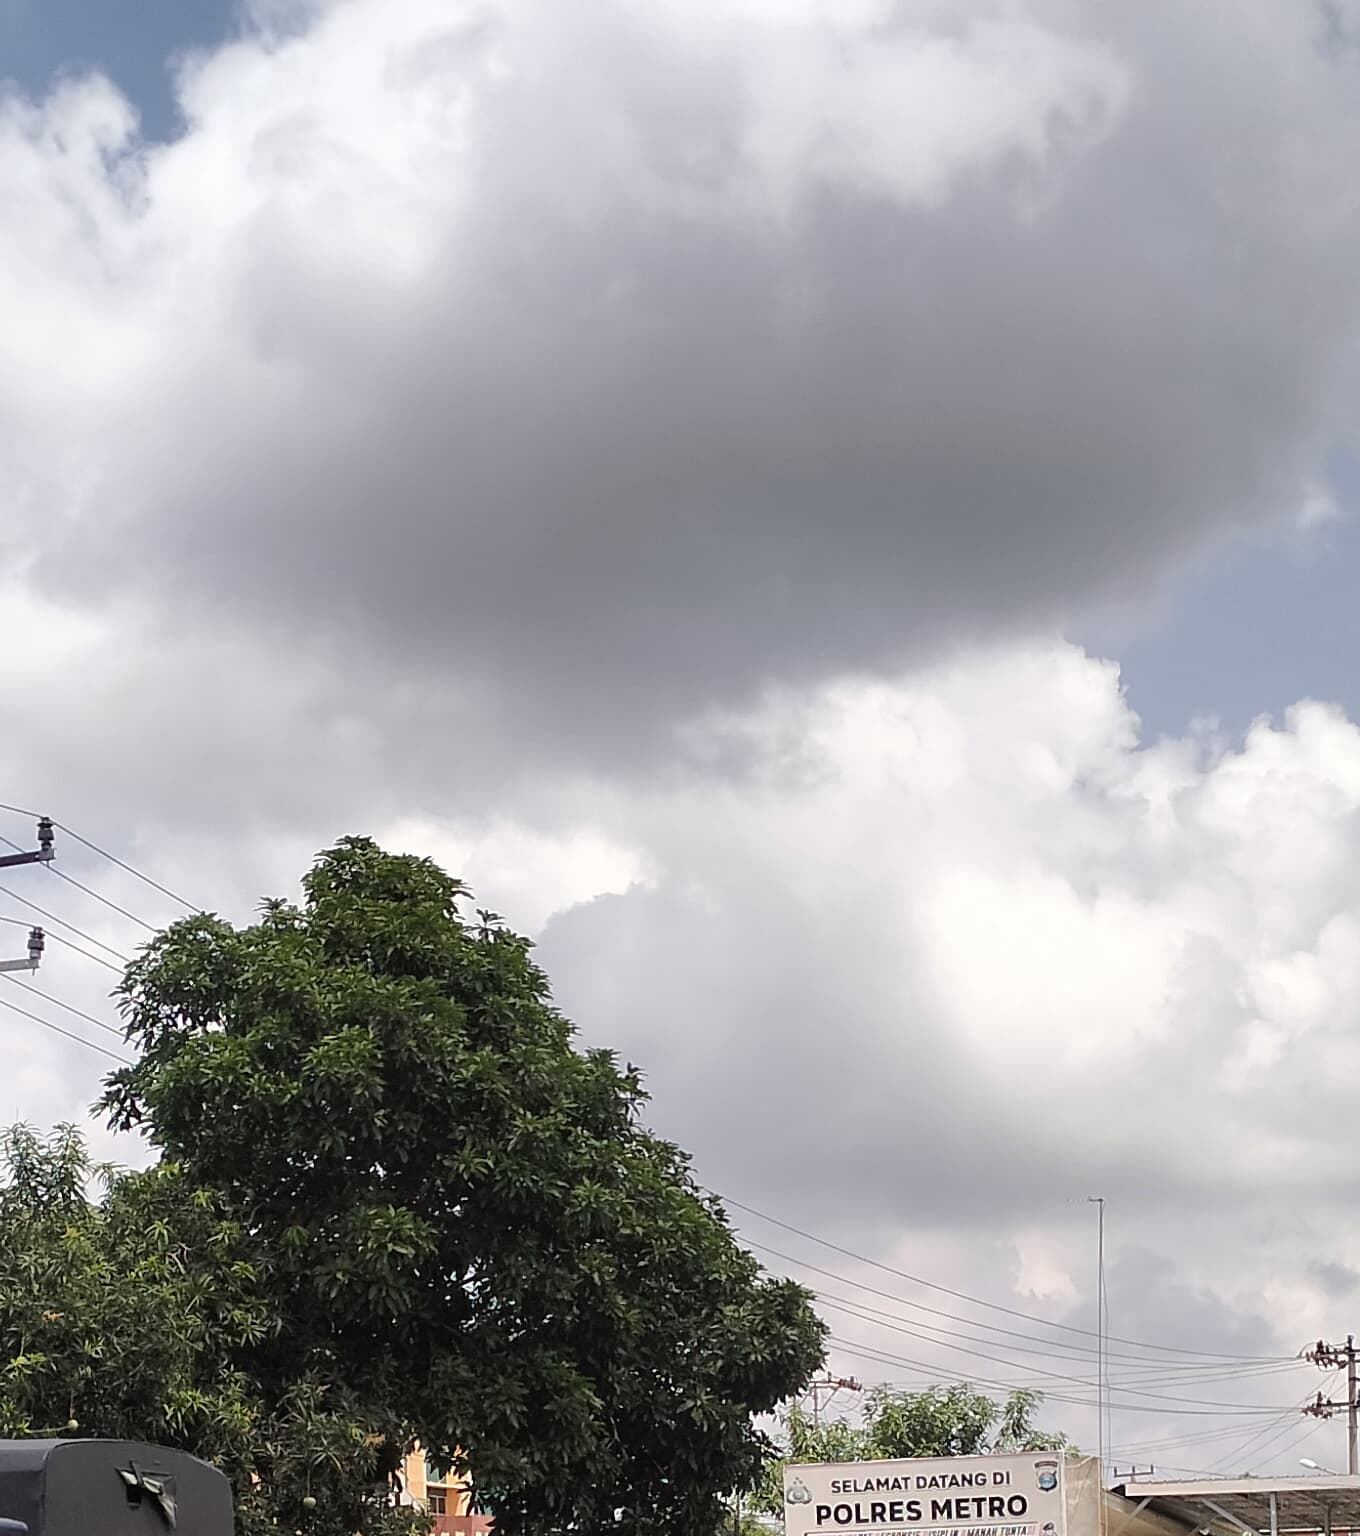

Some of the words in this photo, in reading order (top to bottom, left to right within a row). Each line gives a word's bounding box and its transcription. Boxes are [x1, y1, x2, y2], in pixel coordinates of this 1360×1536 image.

[830, 1476, 911, 1495] SELAMAT
[915, 1472, 987, 1491] DATANG
[992, 1471, 1010, 1486] DI
[815, 1499, 923, 1526] POLRES
[931, 1494, 1028, 1521] METRO
